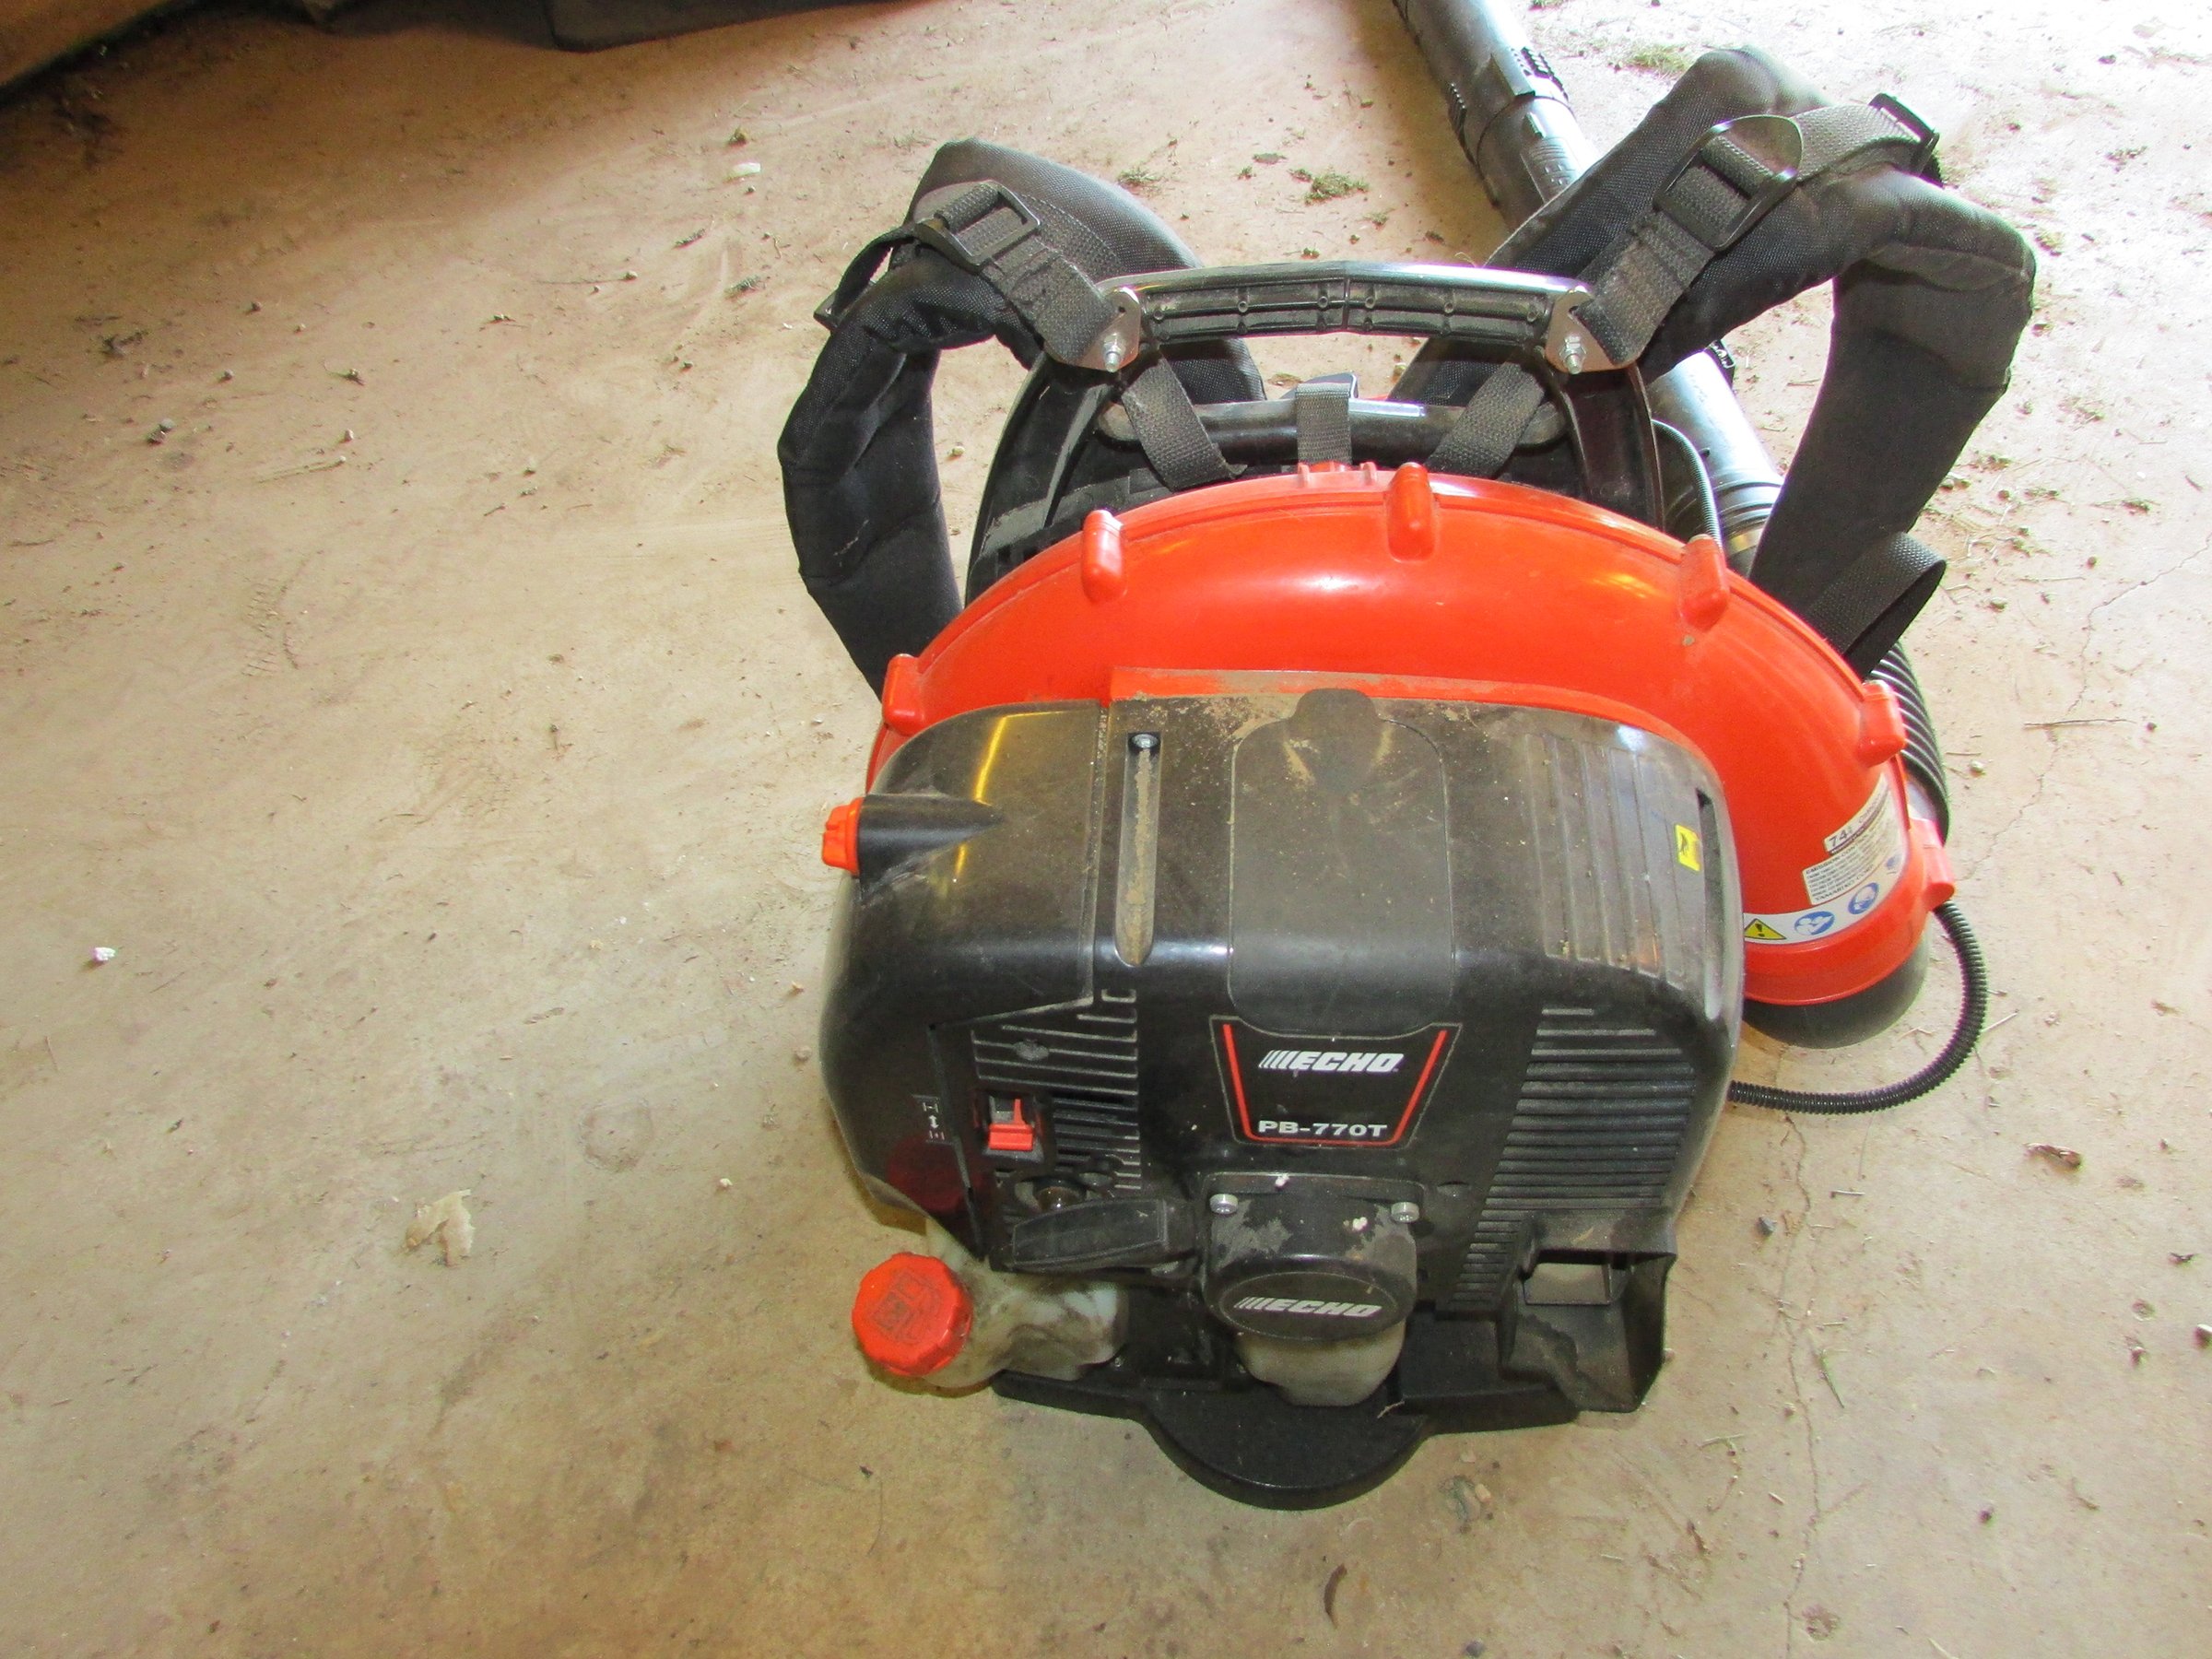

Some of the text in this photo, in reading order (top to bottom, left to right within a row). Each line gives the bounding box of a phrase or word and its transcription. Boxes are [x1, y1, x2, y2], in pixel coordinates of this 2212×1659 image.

[1286, 1051, 1404, 1072] ECHO
[1258, 1120, 1388, 1137] PB-770T
[1261, 1298, 1382, 1317] ECHO
